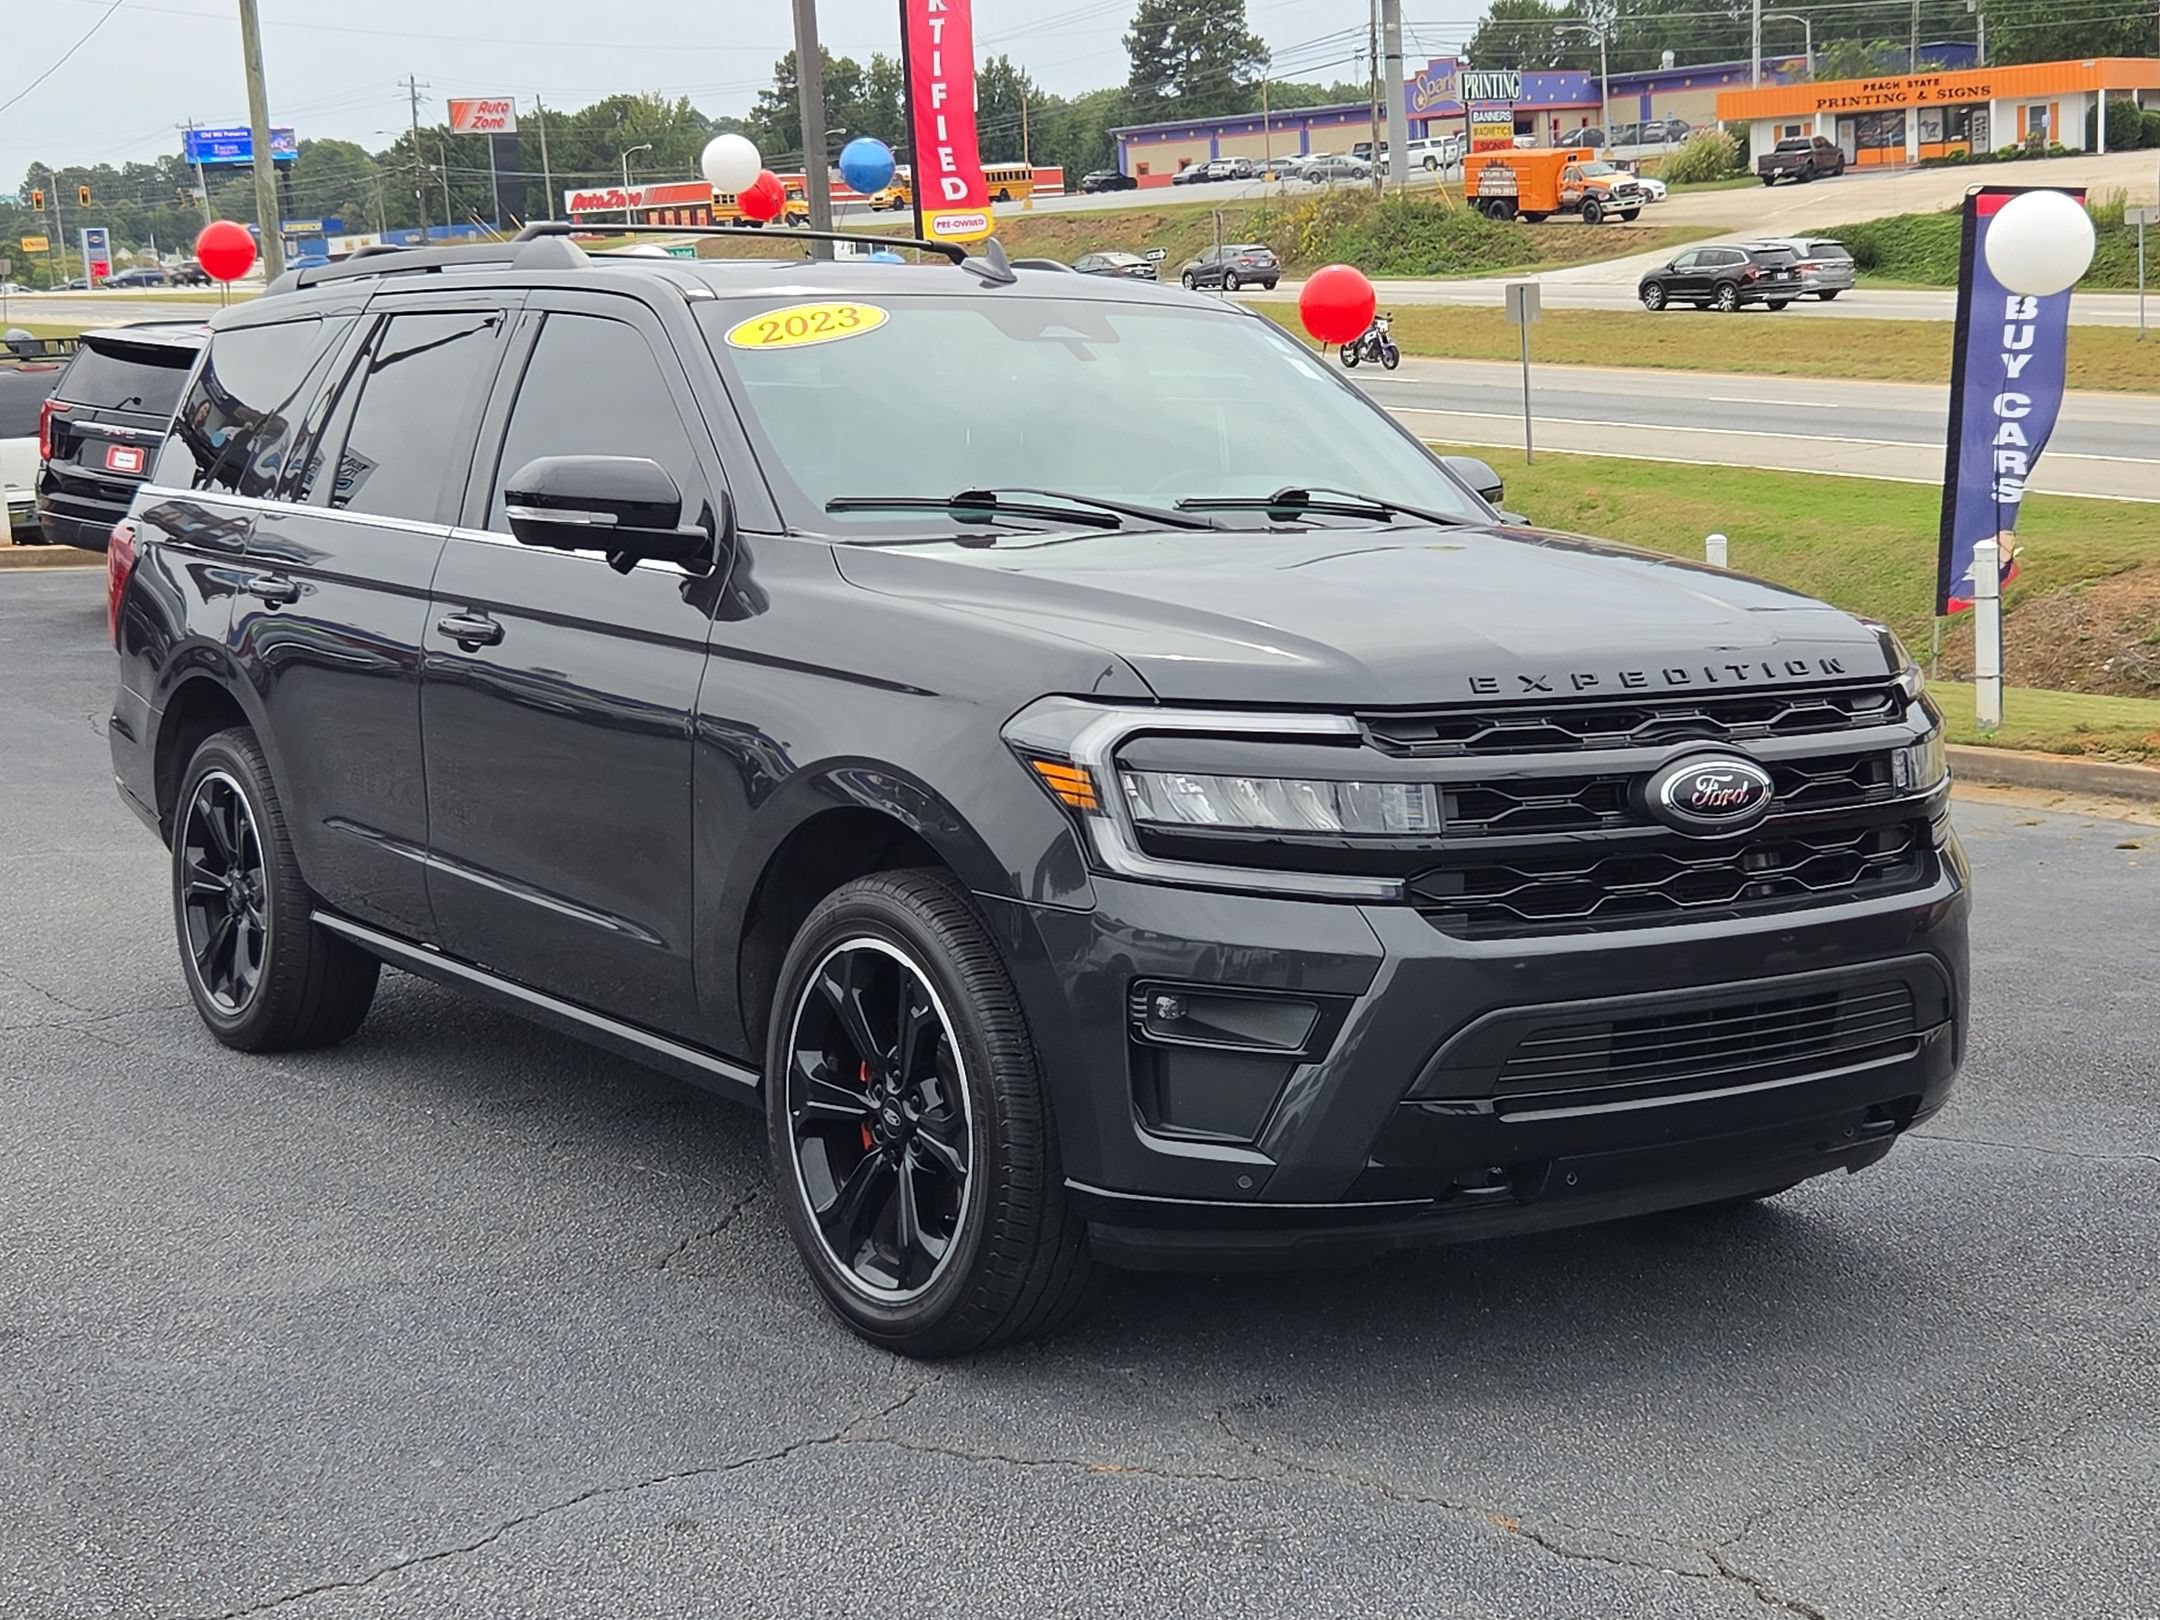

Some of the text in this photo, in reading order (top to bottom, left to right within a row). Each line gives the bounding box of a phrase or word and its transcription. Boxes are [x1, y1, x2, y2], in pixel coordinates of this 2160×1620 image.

[1463, 73, 1520, 100] PRINTING
[1863, 78, 1940, 92] PEACH STATE
[1816, 85, 1992, 109] PRINTING & SIGNS
[477, 101, 509, 114] Auto
[1473, 111, 1512, 123] BANNERS
[470, 116, 505, 129] Zone
[1480, 142, 1507, 151] SIGNS
[936, 218, 985, 229] PRE-OWNED
[758, 307, 861, 344] 2023
[1990, 296, 2039, 504] BUY CARS
[1469, 657, 1848, 695] EXPEDITION
[1691, 774, 1751, 808] Ford
